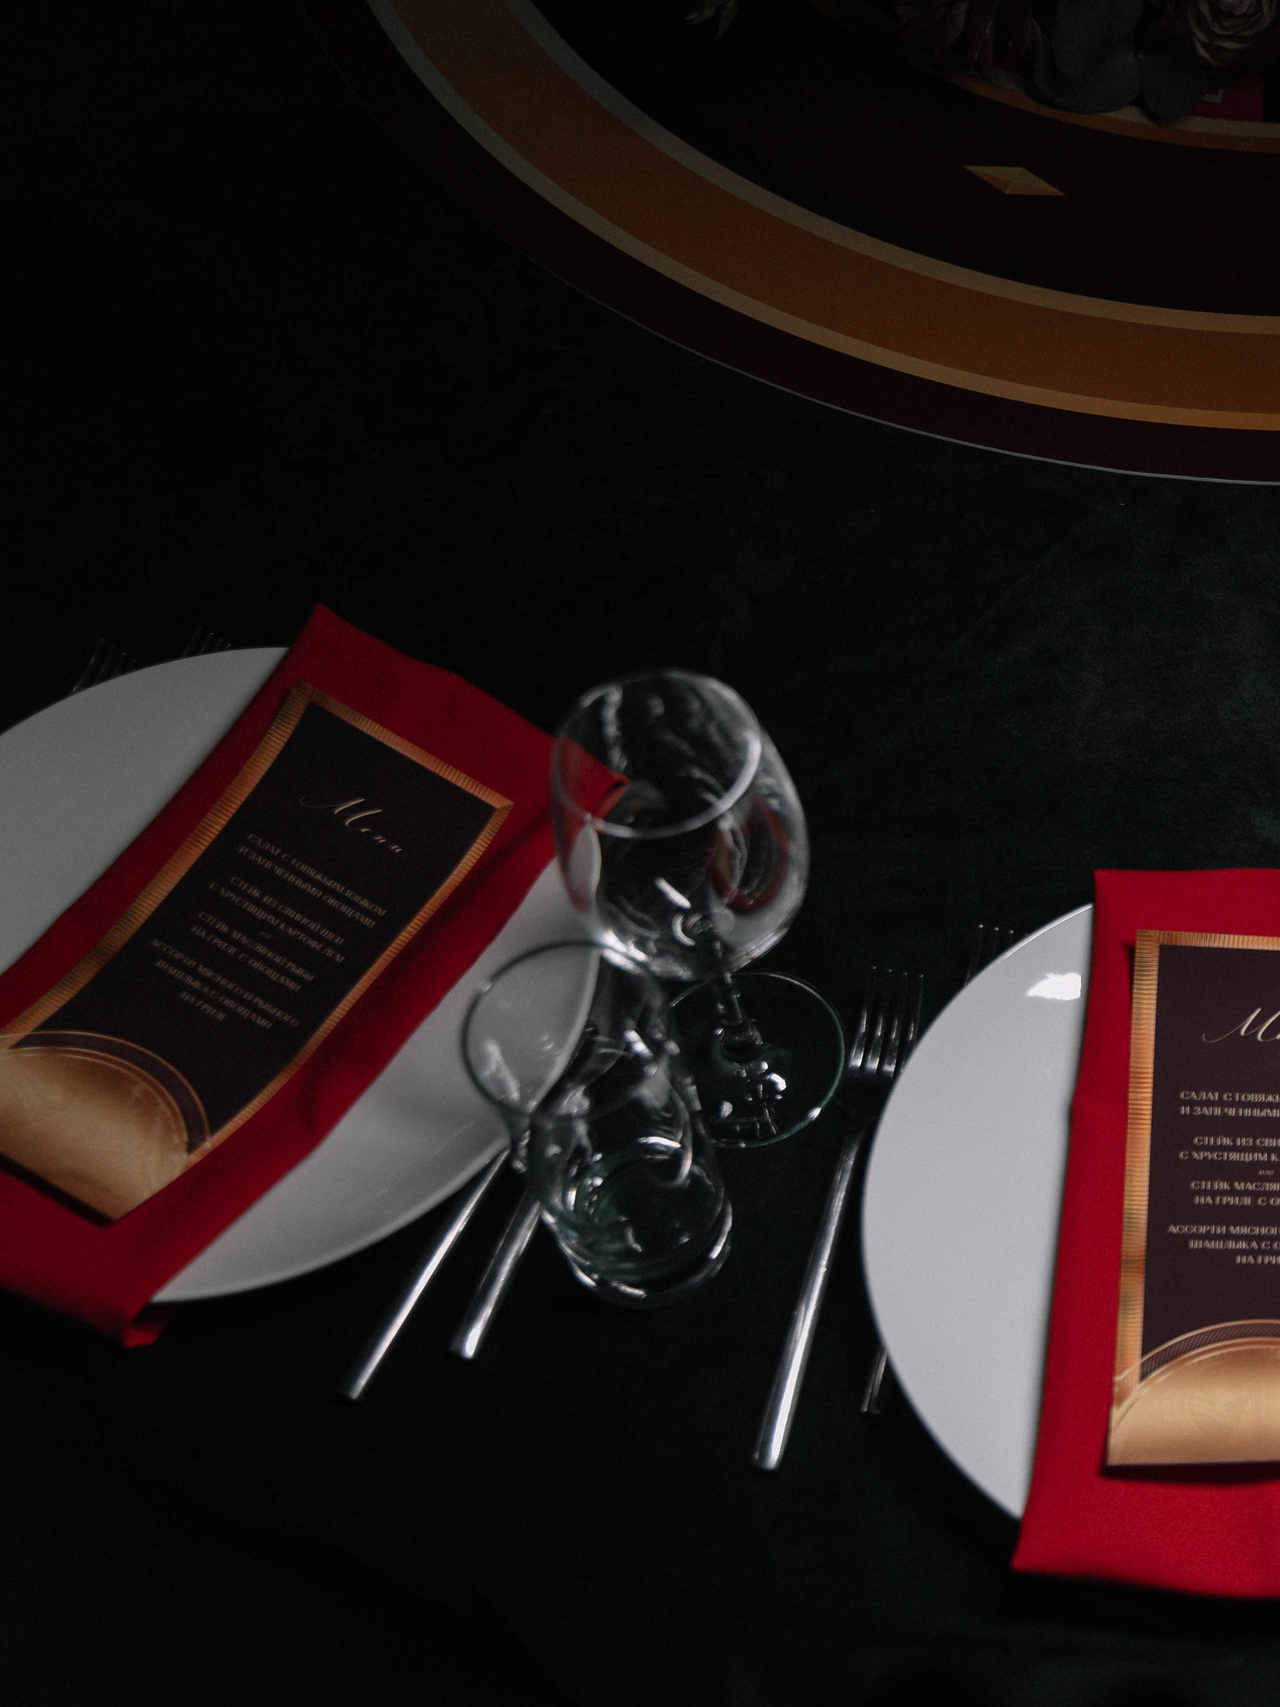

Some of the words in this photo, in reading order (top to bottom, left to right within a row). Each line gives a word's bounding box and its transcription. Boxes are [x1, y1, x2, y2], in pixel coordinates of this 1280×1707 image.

[300, 796, 404, 855] Menu
[1180, 1090, 1219, 1101] САЛАТ
[1223, 1091, 1232, 1101] С
[1180, 1105, 1190, 1116] И
[1194, 1134, 1233, 1146] СТЕЙК
[1236, 1137, 1253, 1147] ИЗ
[1179, 1150, 1189, 1160] С
[1193, 1151, 1267, 1163] ХРУСТЯЩИМ
[1191, 1178, 1231, 1191] СТЕЙК
[1194, 1194, 1213, 1205] НА
[1215, 1195, 1252, 1206] ГРИЛЕ
[1257, 1196, 1267, 1206] С
[1168, 1223, 1226, 1235] АССОРТИ
[1189, 1239, 1259, 1250] ШАШЛЫКА
[1261, 1240, 1270, 1250] С
[1236, 1254, 1254, 1264] НА
